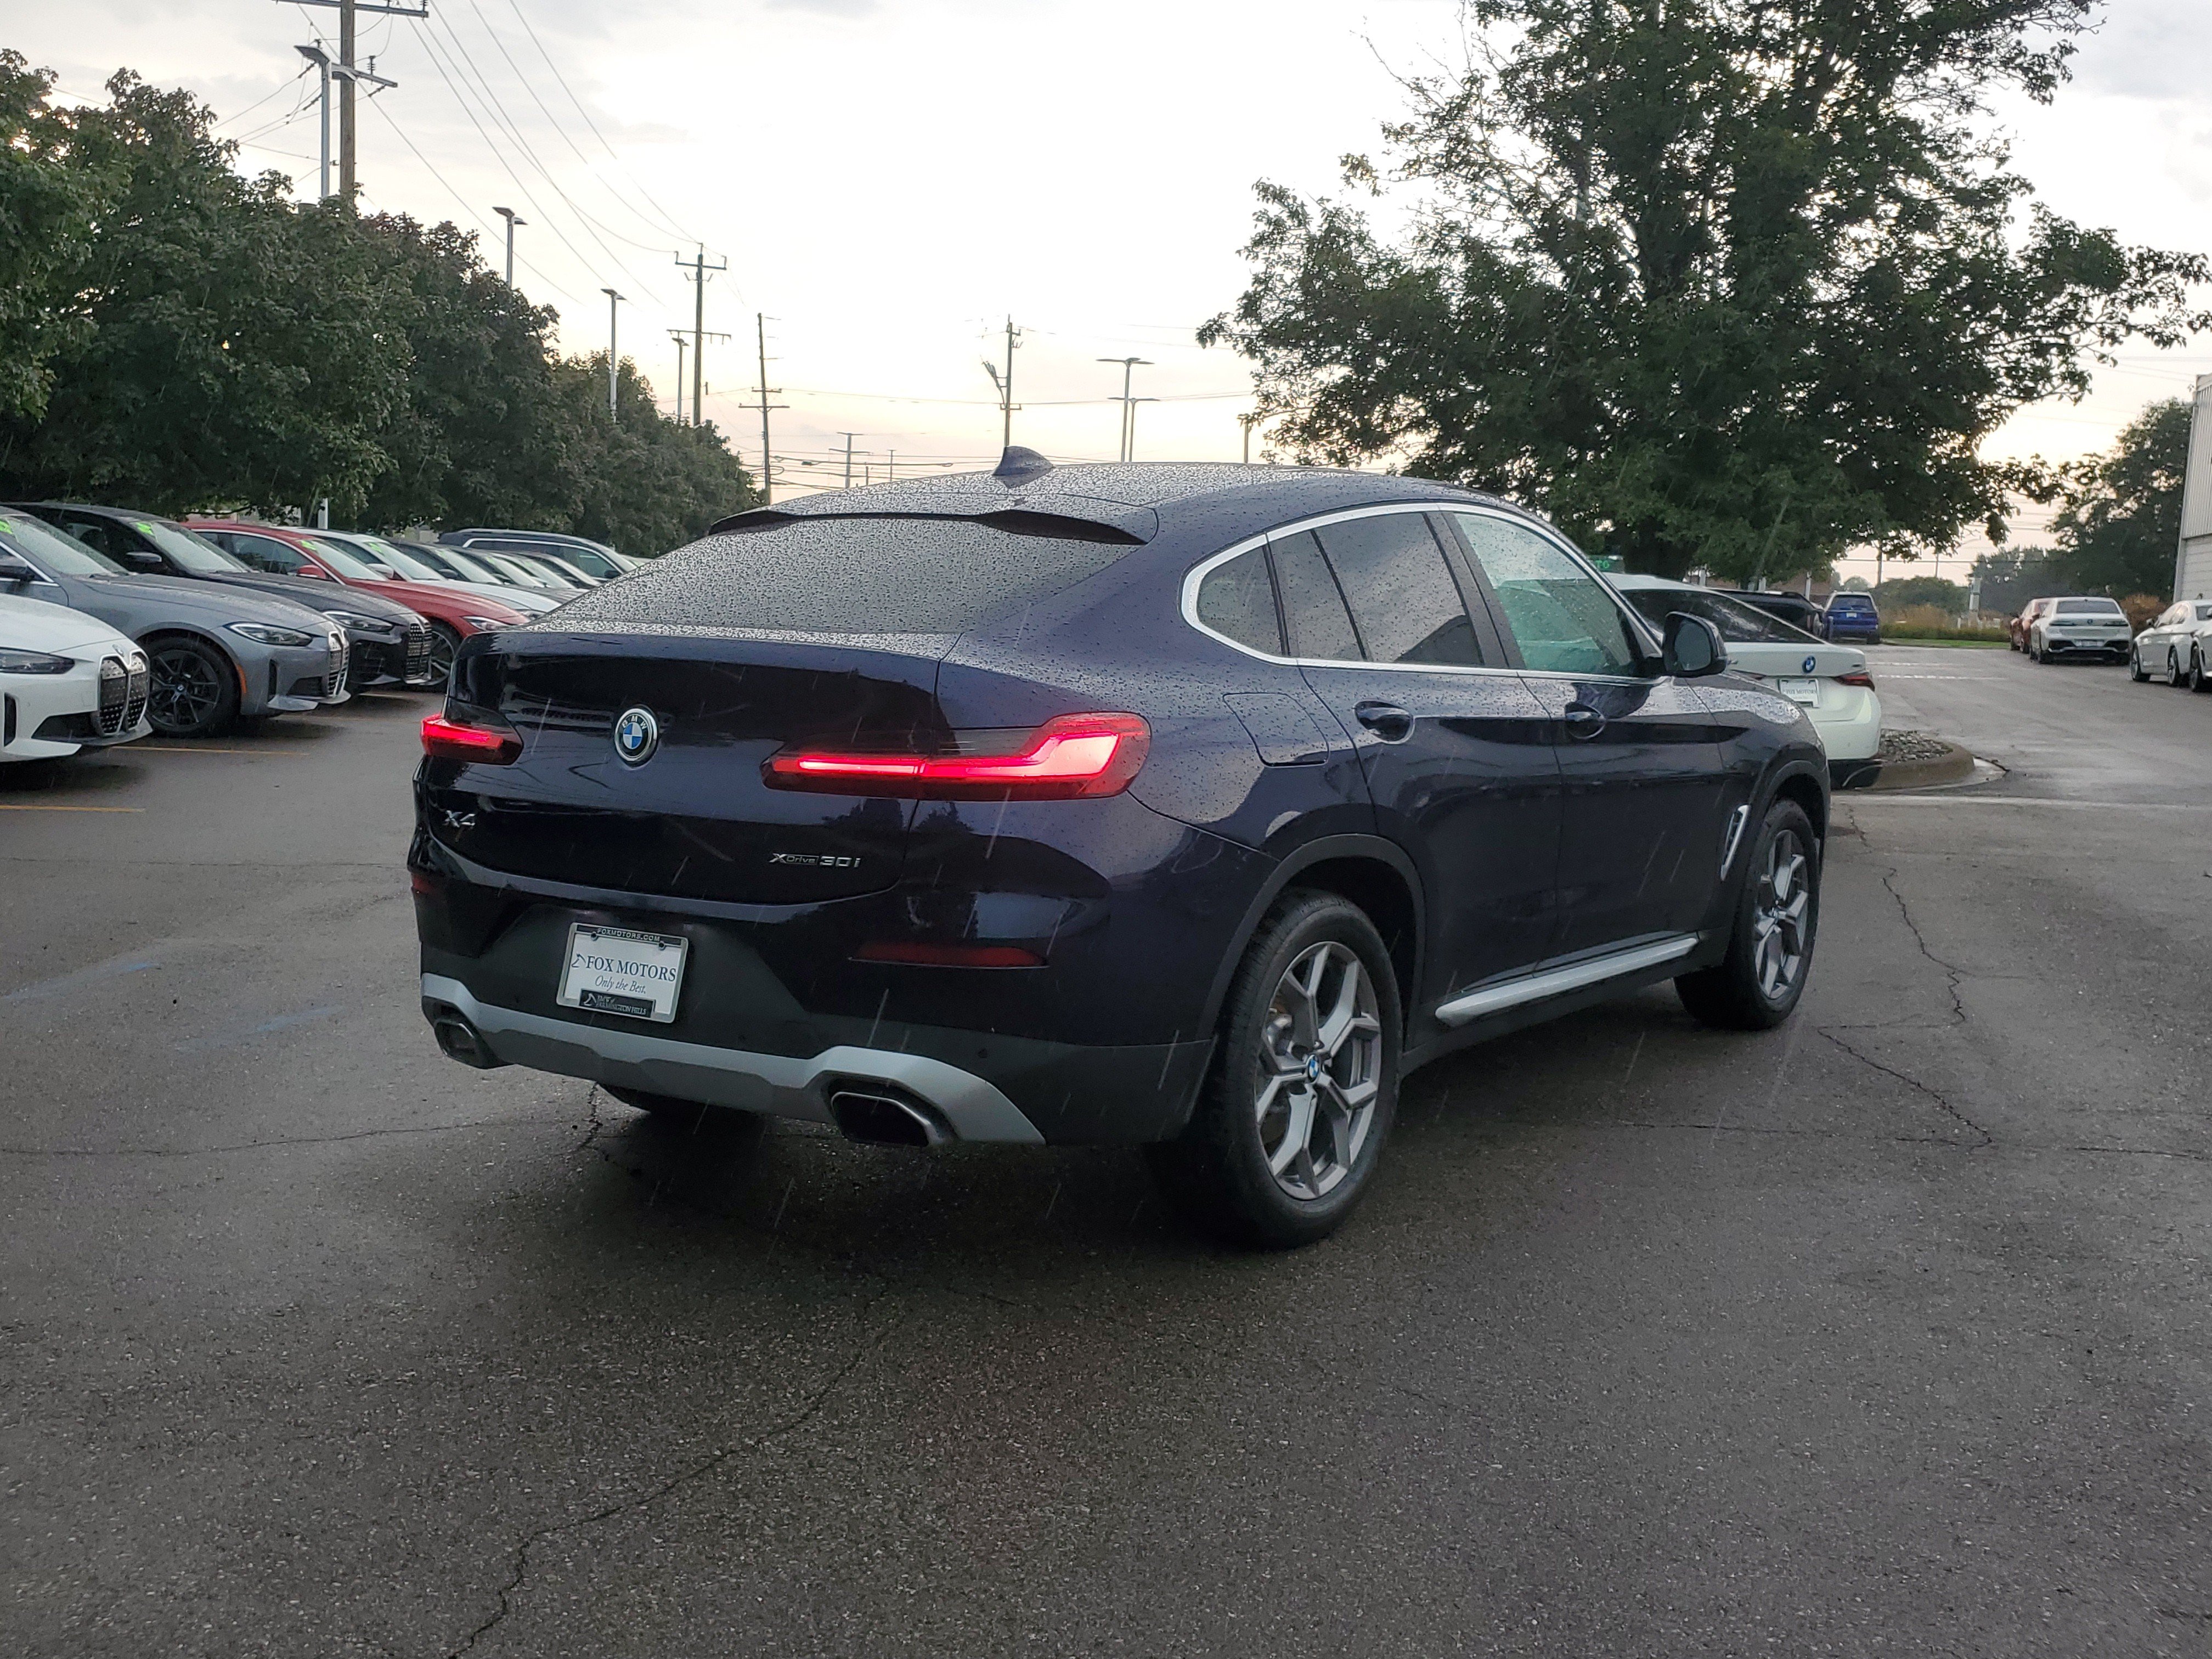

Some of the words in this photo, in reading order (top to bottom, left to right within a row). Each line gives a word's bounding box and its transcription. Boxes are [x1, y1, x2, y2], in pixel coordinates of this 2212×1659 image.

[622, 715, 647, 730] BMW
[444, 810, 476, 827] X4
[597, 928, 661, 942] FOXMOTORS.COM
[585, 955, 614, 972] FOX
[616, 960, 676, 981] MOTORS
[595, 975, 614, 991] Only
[615, 978, 629, 991] the
[629, 980, 646, 994] Best.
